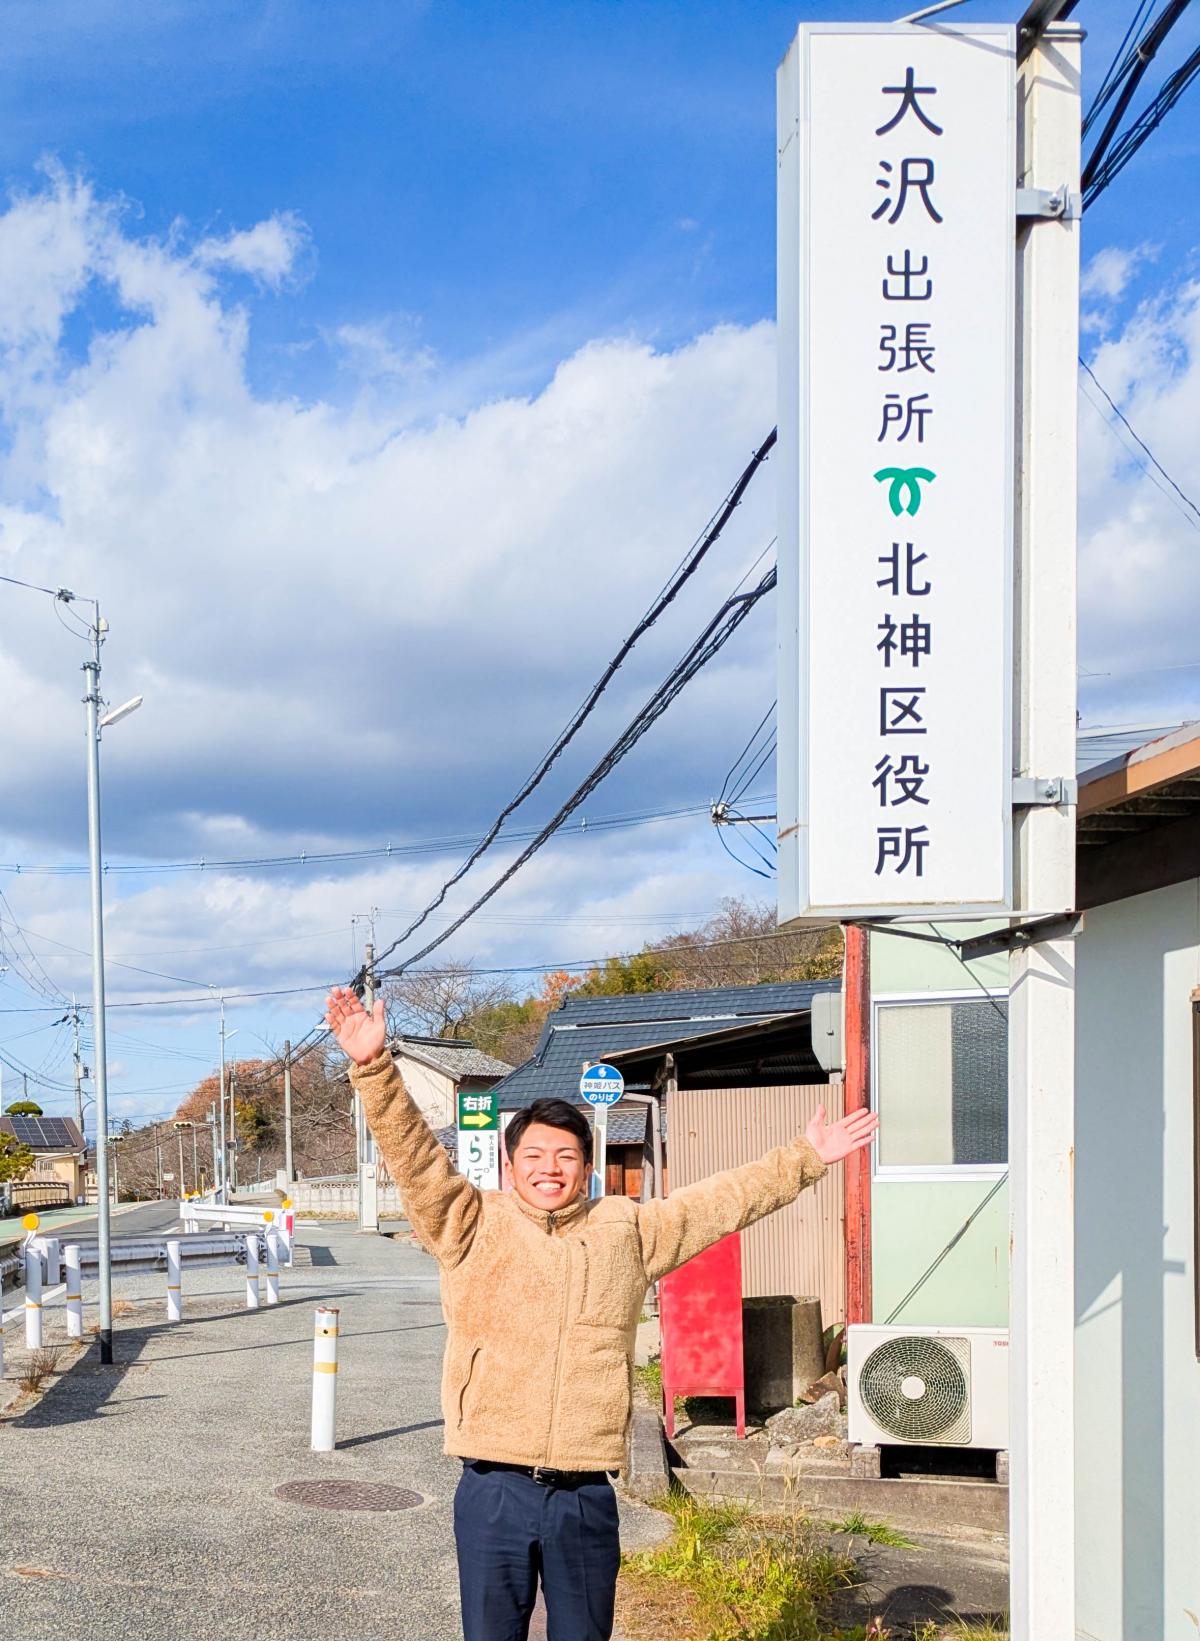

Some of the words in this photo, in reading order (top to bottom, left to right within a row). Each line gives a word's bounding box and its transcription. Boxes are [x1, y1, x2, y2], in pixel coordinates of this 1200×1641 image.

[871, 66, 943, 443] 大沢出張所
[871, 542, 932, 877] 北神区役所
[463, 1095, 493, 1111] 右折
[589, 1093, 614, 1102] のりば
